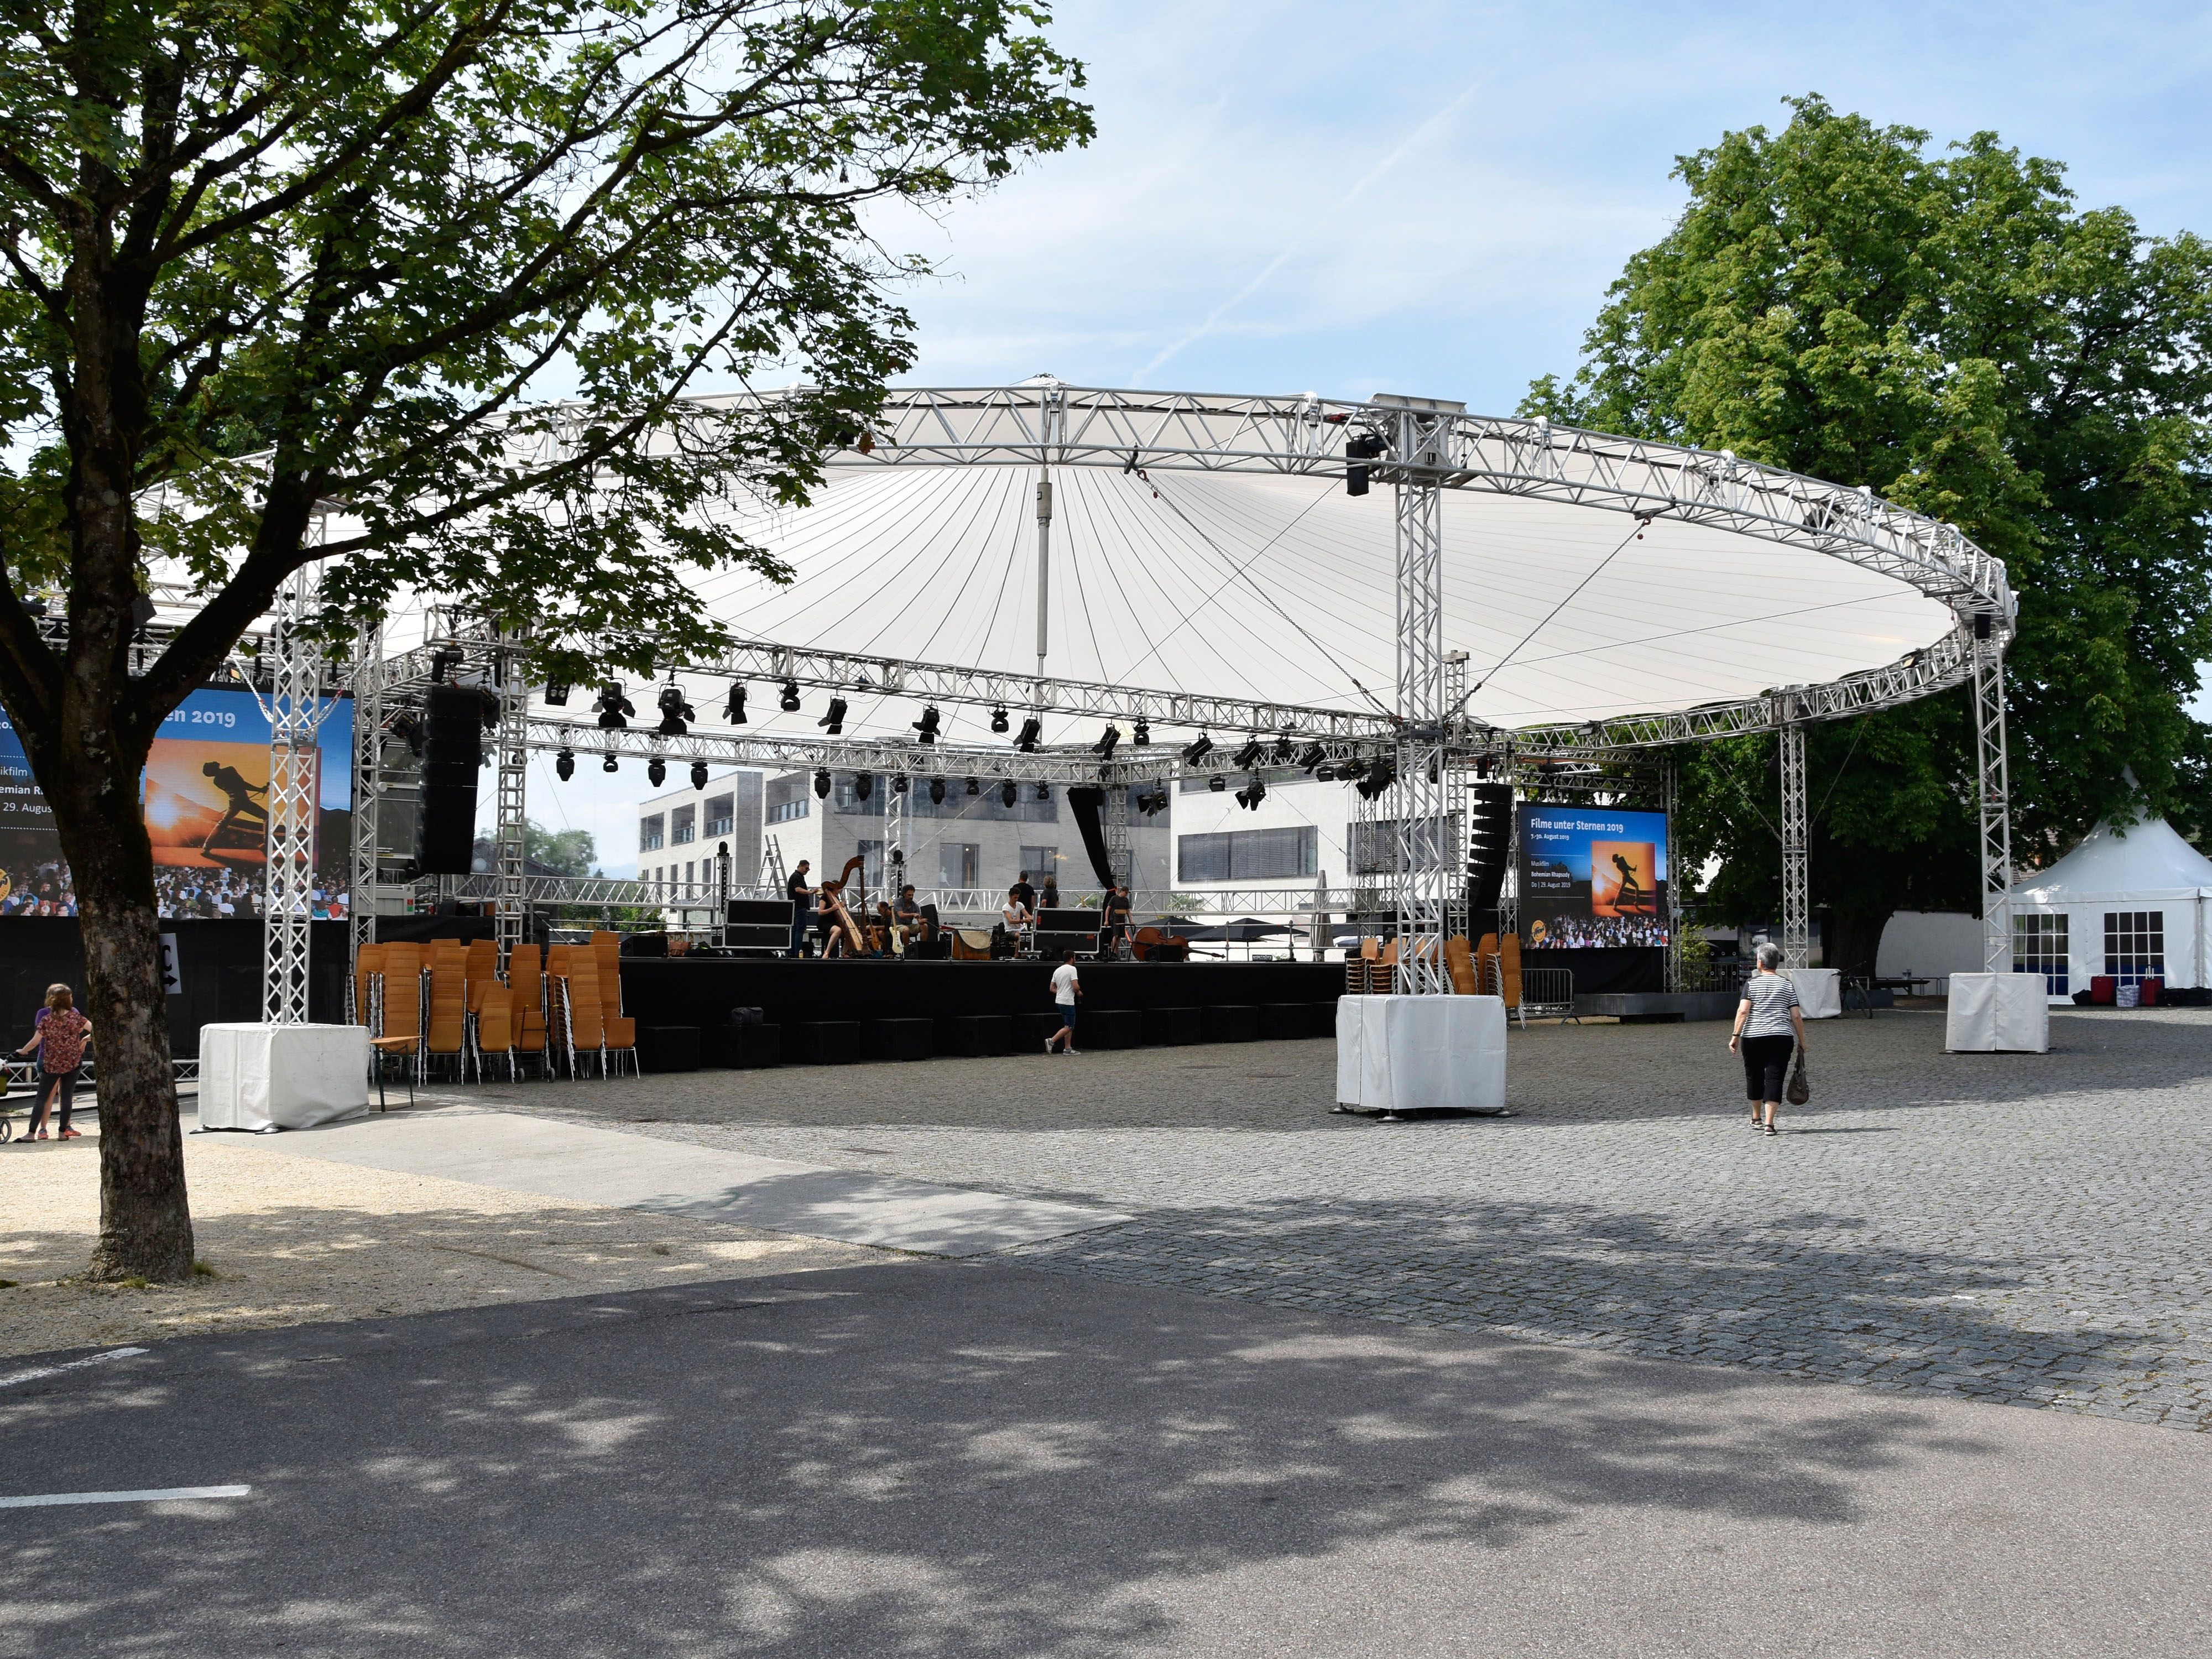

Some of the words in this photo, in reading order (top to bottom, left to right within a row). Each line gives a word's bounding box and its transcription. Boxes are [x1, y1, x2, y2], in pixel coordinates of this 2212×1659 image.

[0, 721, 13, 729] 0.
[192, 711, 236, 728] 2019
[3, 802, 18, 812] 29.
[1531, 818, 1552, 829] Filme
[1553, 820, 1575, 830] unter
[1576, 821, 1605, 831] Sternen
[1607, 823, 1624, 833] 2019
